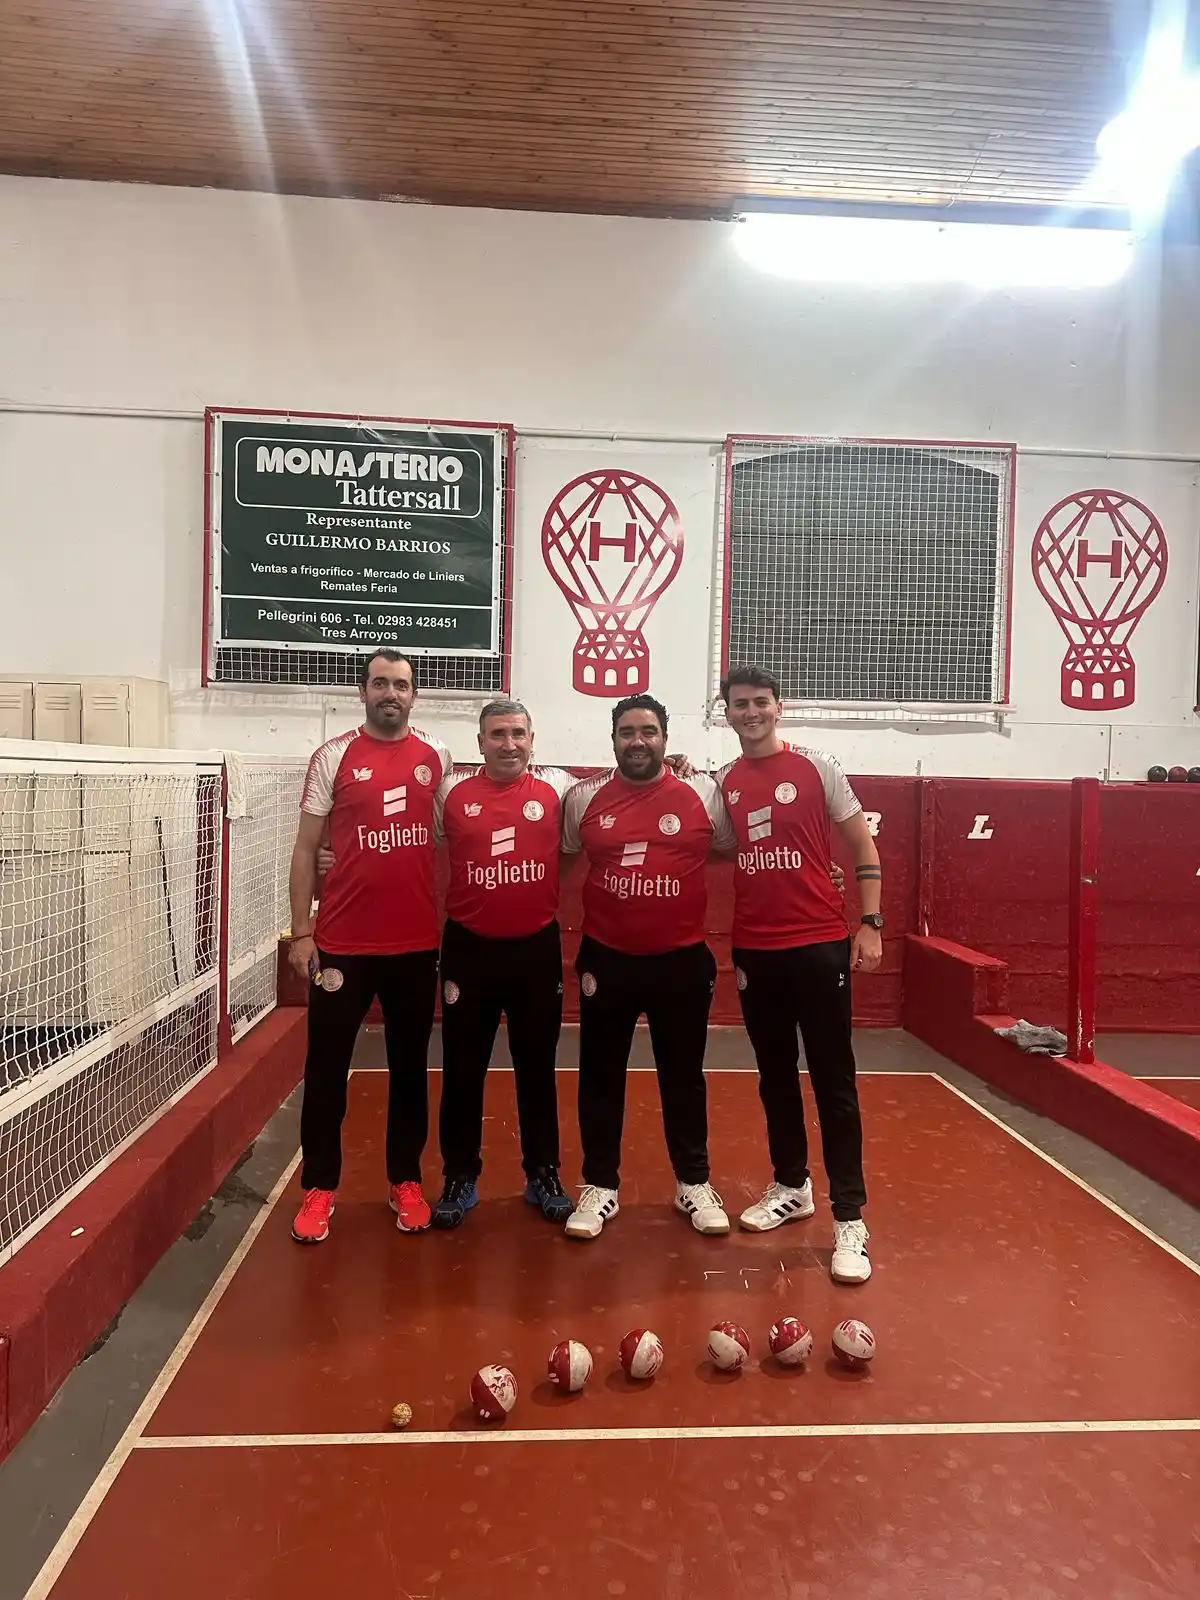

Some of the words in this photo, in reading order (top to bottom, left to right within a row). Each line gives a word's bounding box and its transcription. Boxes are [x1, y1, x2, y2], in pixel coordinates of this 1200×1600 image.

[256, 446, 464, 482] MONASTERIO
[335, 479, 461, 511] Tattersall
[306, 512, 412, 530] Representante
[265, 533, 372, 551] GUILLERMO
[375, 538, 451, 554] BARRIOS
[251, 563, 289, 574] Ventas
[290, 566, 298, 575] a
[300, 564, 354, 579] frigorífico
[363, 567, 410, 580] Mercado
[412, 570, 426, 580] de
[428, 571, 465, 582] Liniers
[320, 580, 368, 592] Remates
[370, 582, 398, 593] Feria
[257, 609, 317, 626] Pellegrini
[320, 612, 342, 624] 606
[353, 614, 374, 625] Tel.
[377, 615, 413, 627] 02983
[415, 615, 458, 628] 428451
[320, 626, 347, 638] Tres
[350, 627, 398, 640] Arroyos
[357, 822, 428, 853] Foglietto
[967, 815, 994, 839] L
[738, 845, 802, 875] oglietto
[466, 859, 545, 890] Foglietto
